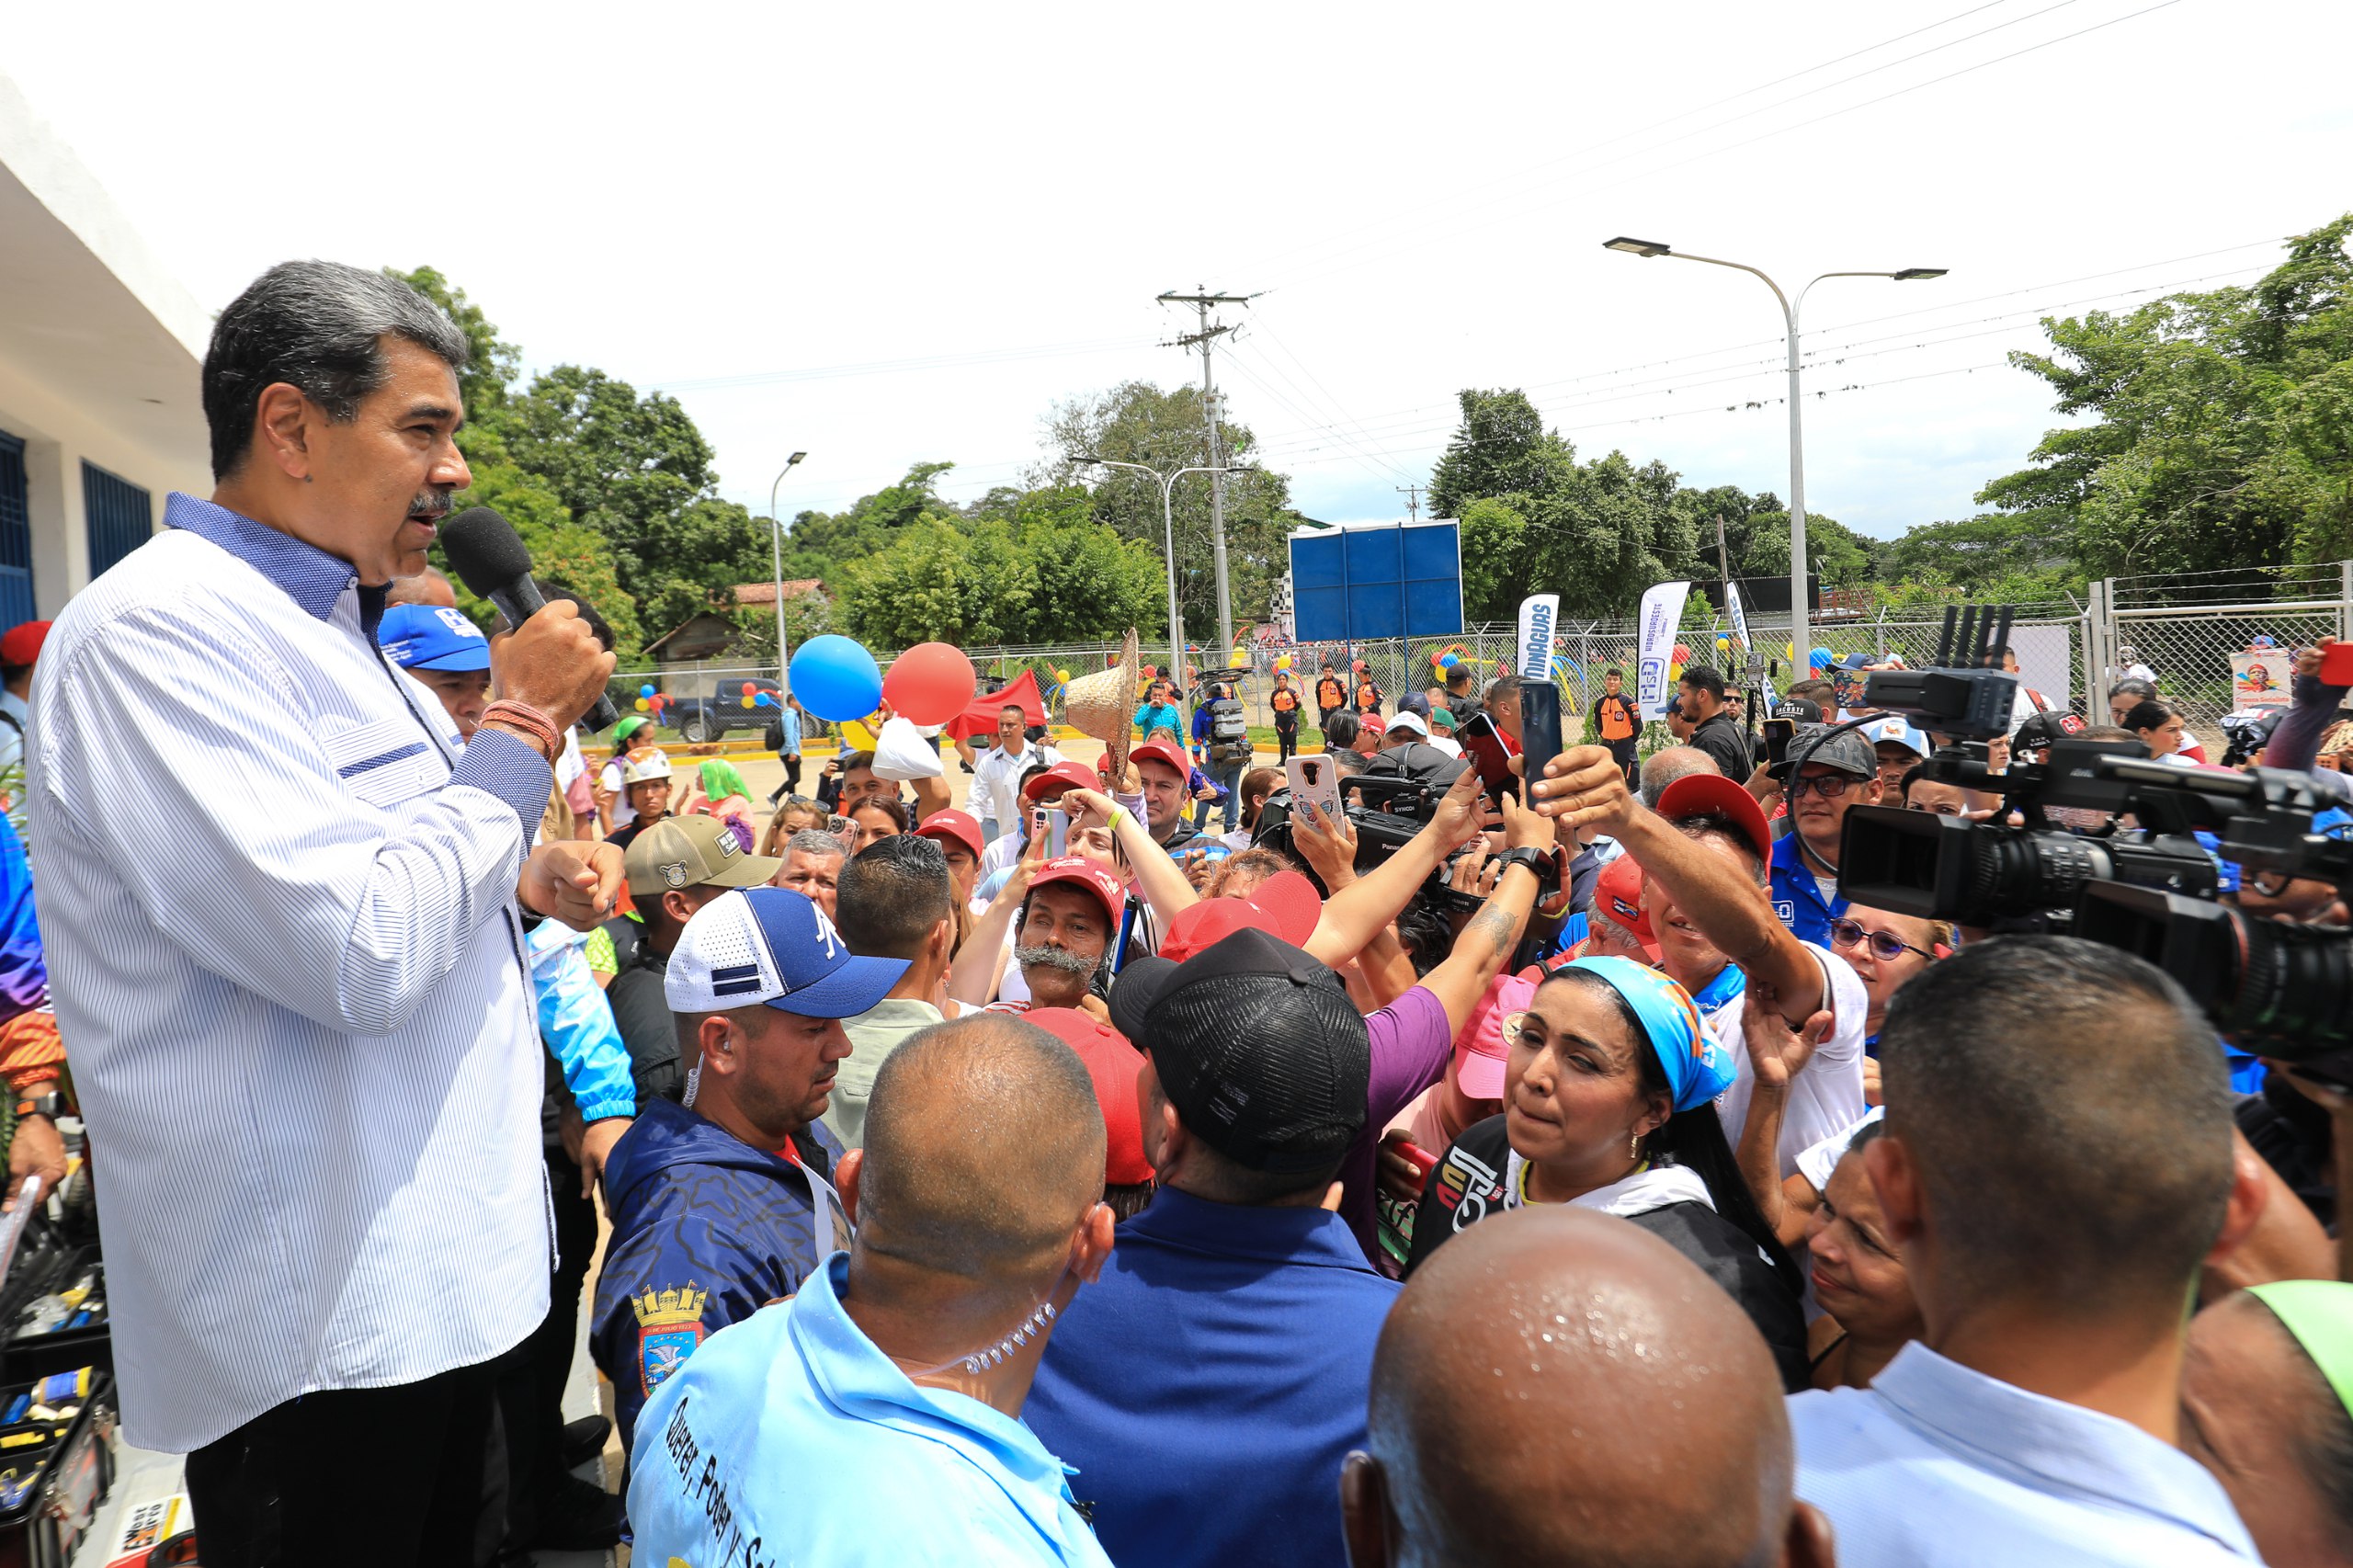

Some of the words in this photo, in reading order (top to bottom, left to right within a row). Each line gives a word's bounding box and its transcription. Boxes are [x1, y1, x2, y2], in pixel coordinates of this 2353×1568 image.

[1776, 706, 1804, 714] LACOSTE
[666, 1396, 699, 1495] Querer,
[696, 1454, 731, 1544] Poder
